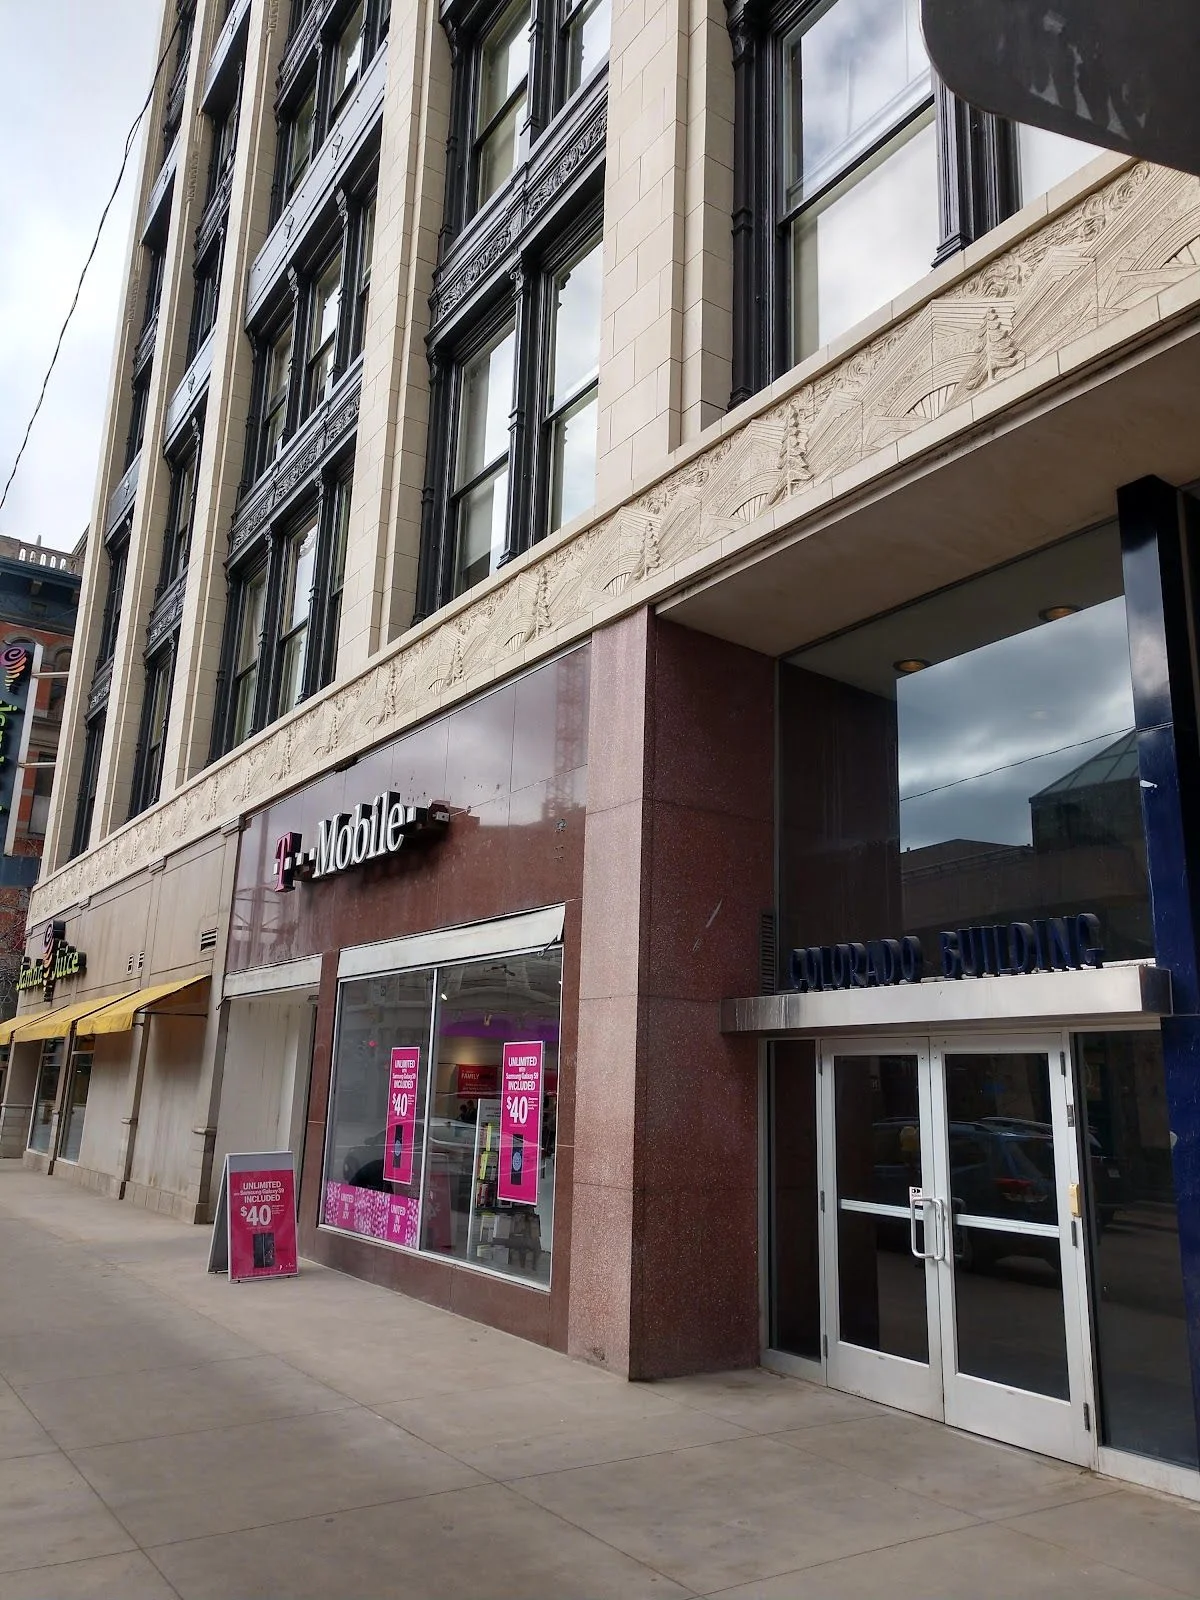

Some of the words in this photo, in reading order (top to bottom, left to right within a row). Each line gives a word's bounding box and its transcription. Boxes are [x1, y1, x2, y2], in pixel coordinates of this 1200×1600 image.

[790, 935, 922, 991] COLORADO
[940, 912, 1104, 978] BUILDING
[508, 1055, 538, 1067] UNLIMITED
[507, 1080, 536, 1091] INCLUDED
[392, 1092, 408, 1117] $40
[506, 1095, 528, 1124] $40
[242, 1180, 282, 1191] UNLIMITED
[244, 1194, 281, 1204] INCLUDED
[240, 1204, 272, 1226] $40
